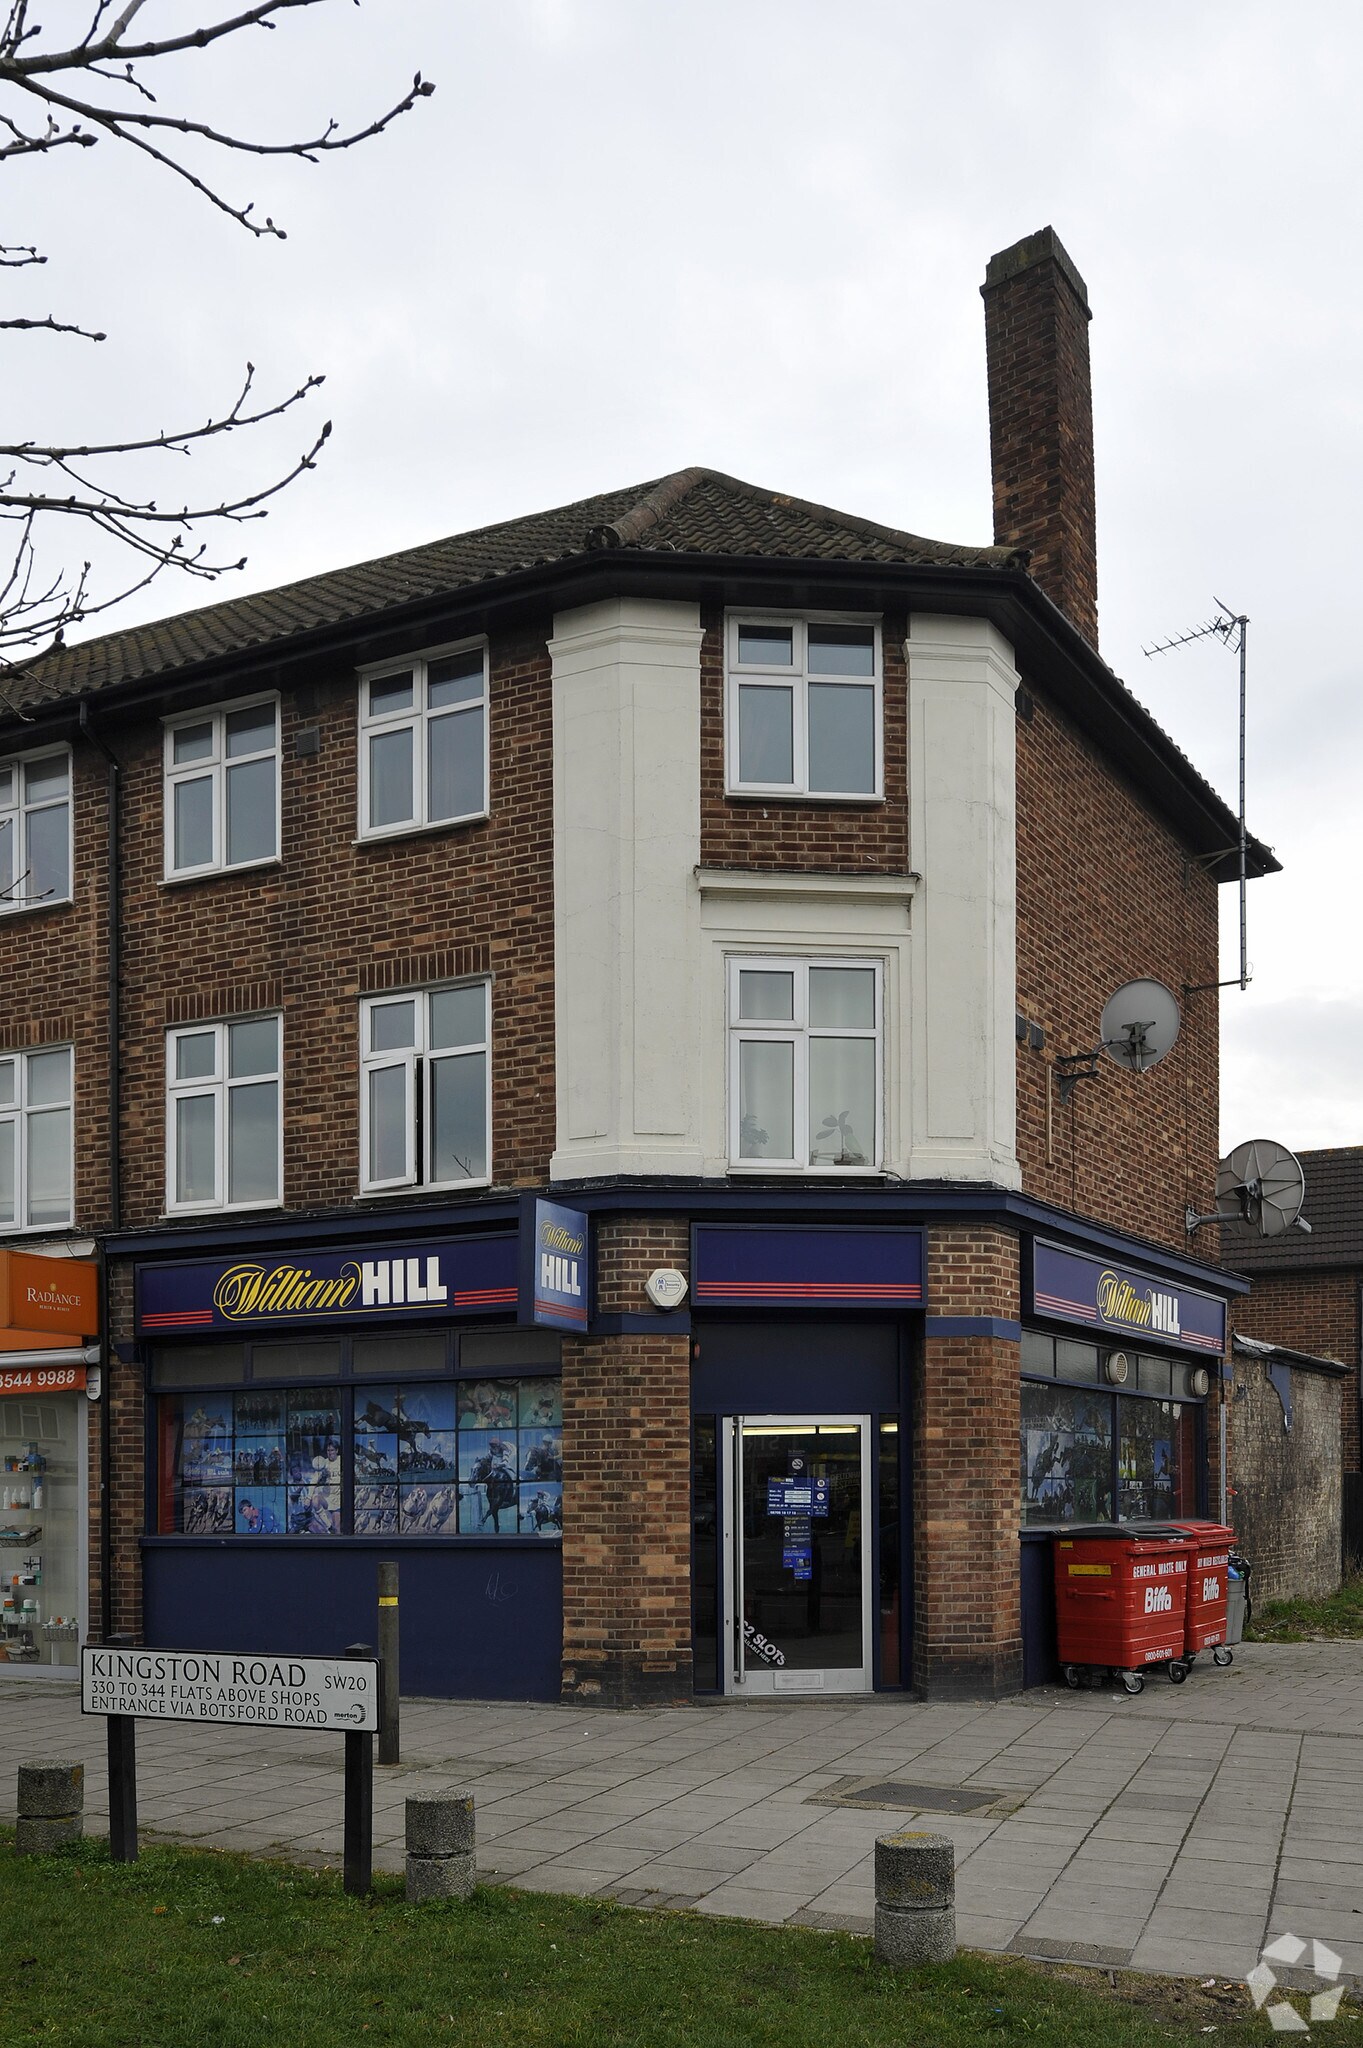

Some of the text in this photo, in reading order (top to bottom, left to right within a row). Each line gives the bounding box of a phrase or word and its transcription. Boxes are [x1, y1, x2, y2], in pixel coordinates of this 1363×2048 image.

[540, 1219, 584, 1256] William
[213, 1256, 448, 1316] William HILL
[541, 1252, 581, 1296] HILL
[27, 1287, 81, 1306] RADIANCE
[1097, 1270, 1180, 1335] William HILL
[37, 1369, 76, 1386] 9988
[1133, 1560, 1187, 1578] GENERAL WASTE ONLY
[1144, 1586, 1172, 1613] Biffa
[1203, 1577, 1219, 1601] Biffa
[752, 1634, 785, 1666] SLOTS
[91, 1653, 367, 1691] KINGSTON ROAD SW20
[91, 1680, 320, 1707] 330 TO 344 FLATS ABOVE SHOPS
[91, 1696, 328, 1724] ENTRANCE VIA BOTSFORD ROAD
[334, 1711, 358, 1719] merton
